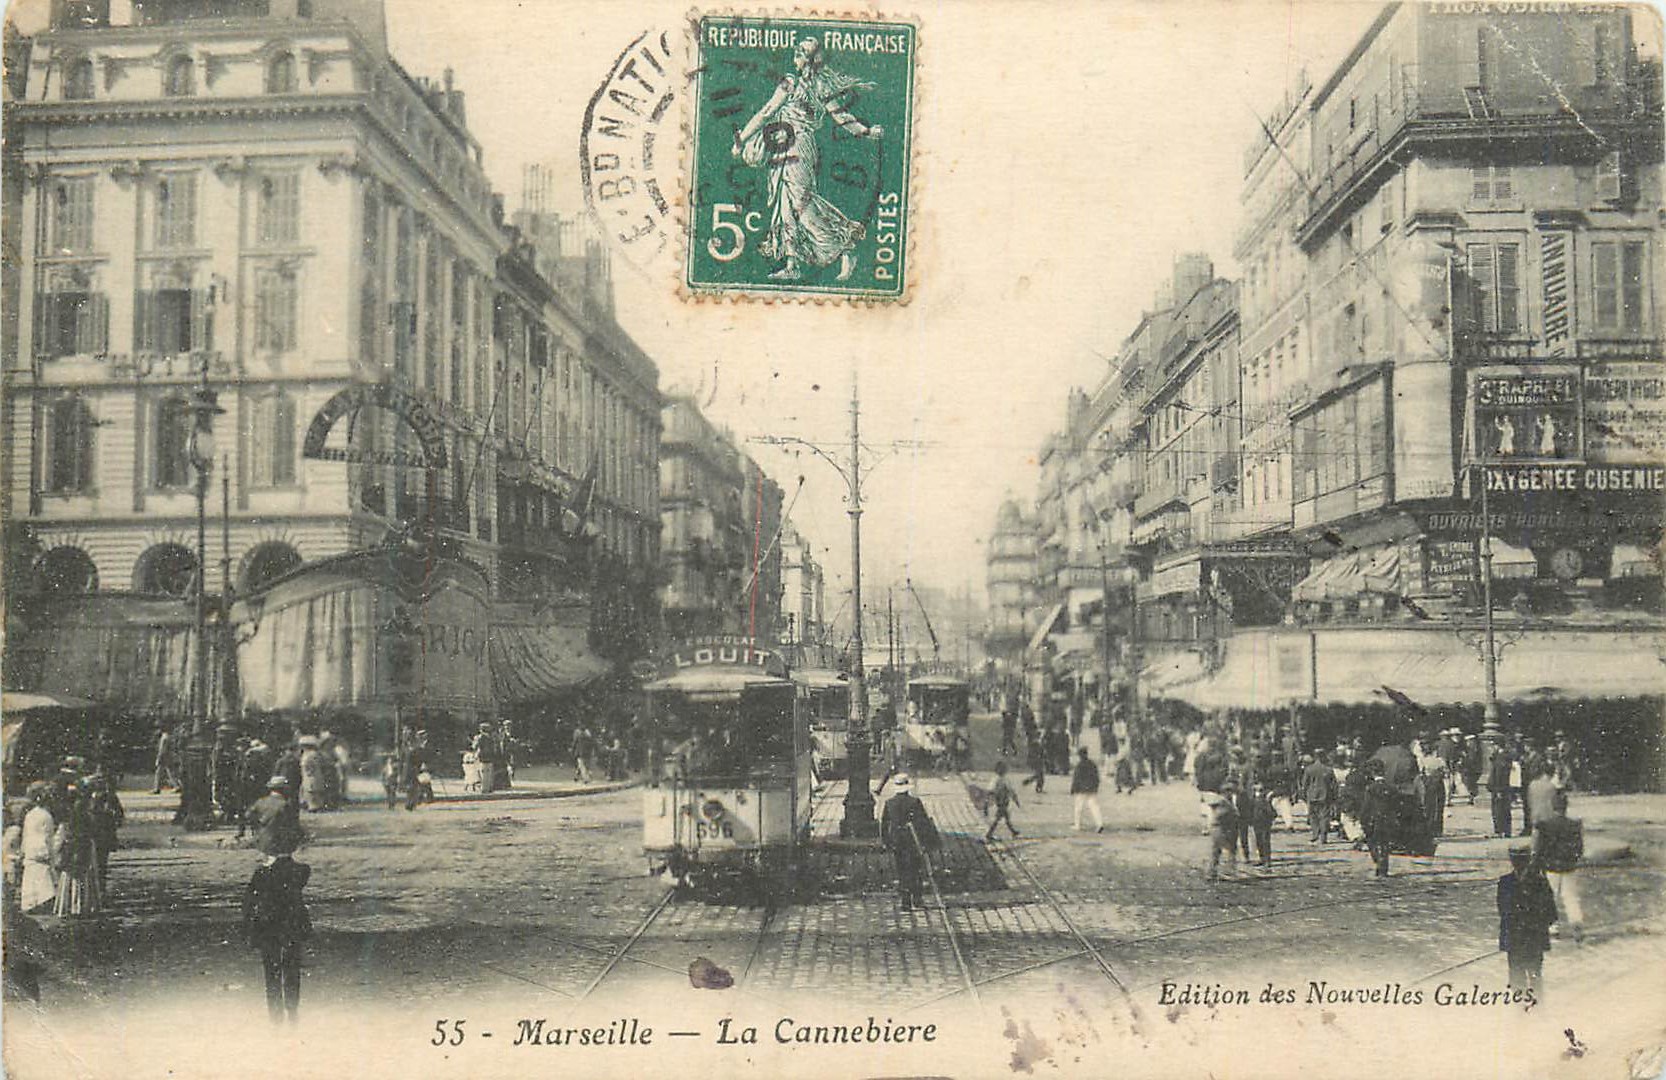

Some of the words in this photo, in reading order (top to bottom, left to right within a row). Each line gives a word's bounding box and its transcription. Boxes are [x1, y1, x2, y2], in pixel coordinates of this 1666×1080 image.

[708, 26, 797, 51] REPUBLIQUE
[824, 31, 906, 54] FRANÇAISE
[874, 192, 898, 280] POSTES
[674, 647, 770, 668] LOUIT
